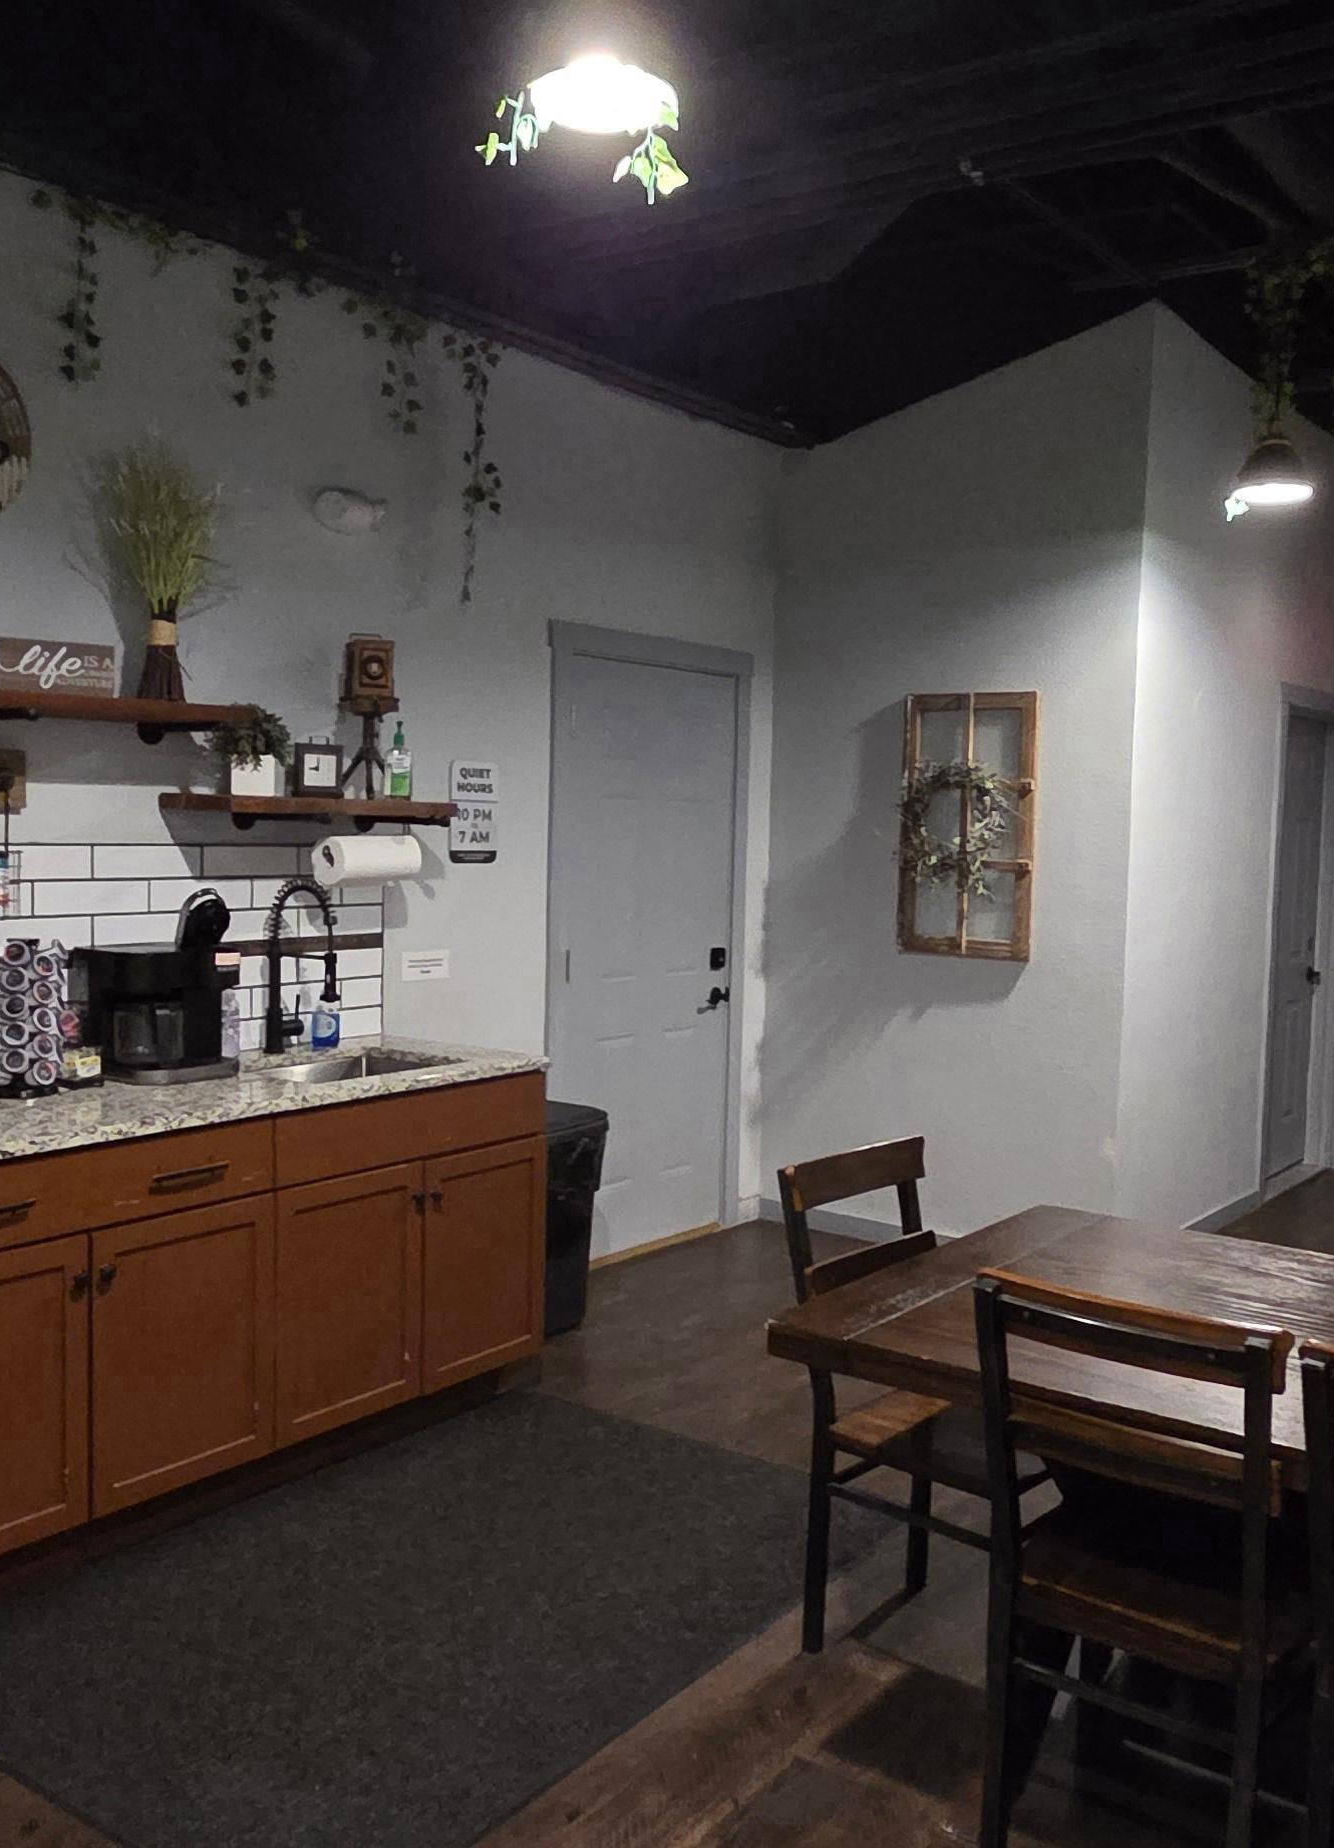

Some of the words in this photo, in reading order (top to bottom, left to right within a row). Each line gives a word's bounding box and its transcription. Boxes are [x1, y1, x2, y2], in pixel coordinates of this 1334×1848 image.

[83, 655, 99, 668] IS
[459, 767, 491, 780] QUIET
[456, 782, 494, 794] HOURS
[473, 808, 492, 821] PM
[458, 831, 466, 843] 7
[469, 831, 490, 843] AM
